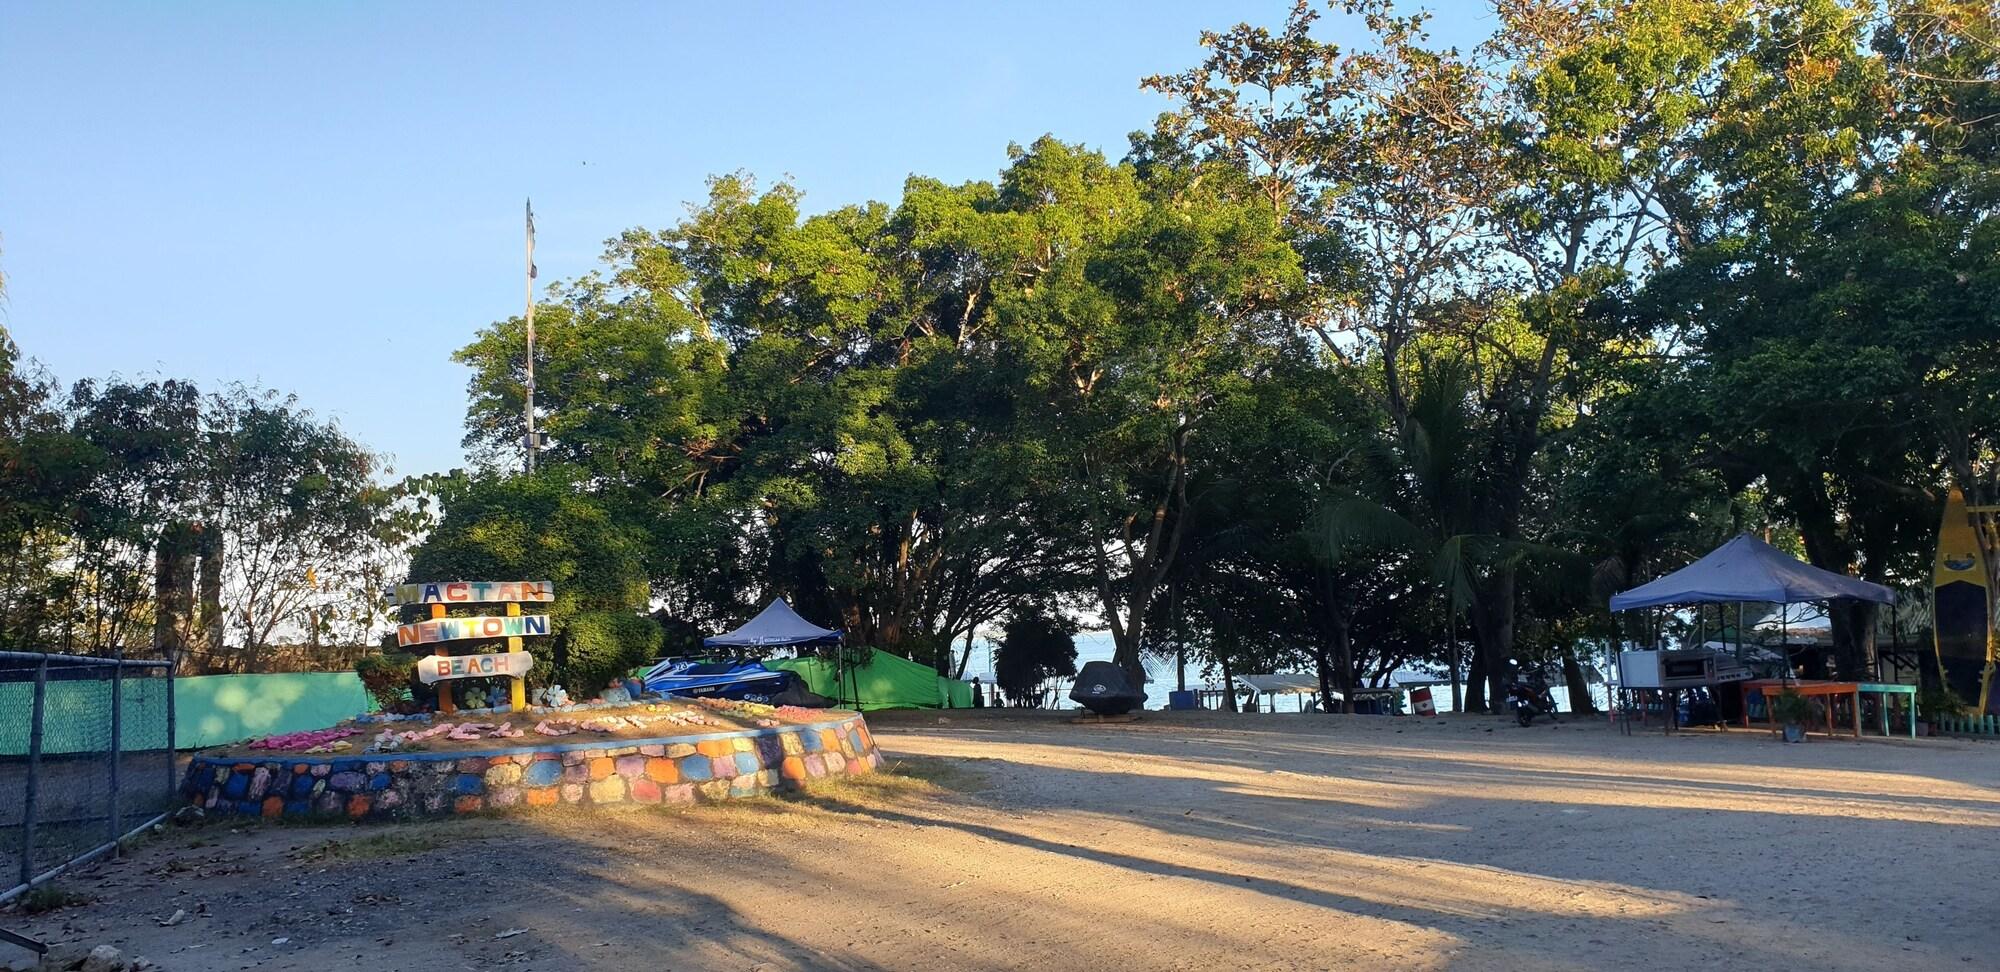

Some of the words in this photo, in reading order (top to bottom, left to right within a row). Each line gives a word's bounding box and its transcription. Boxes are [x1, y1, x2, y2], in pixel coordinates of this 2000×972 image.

[396, 583, 545, 602] MACTAN
[400, 616, 546, 645] NEWTOWN
[437, 657, 509, 676] BEACH
